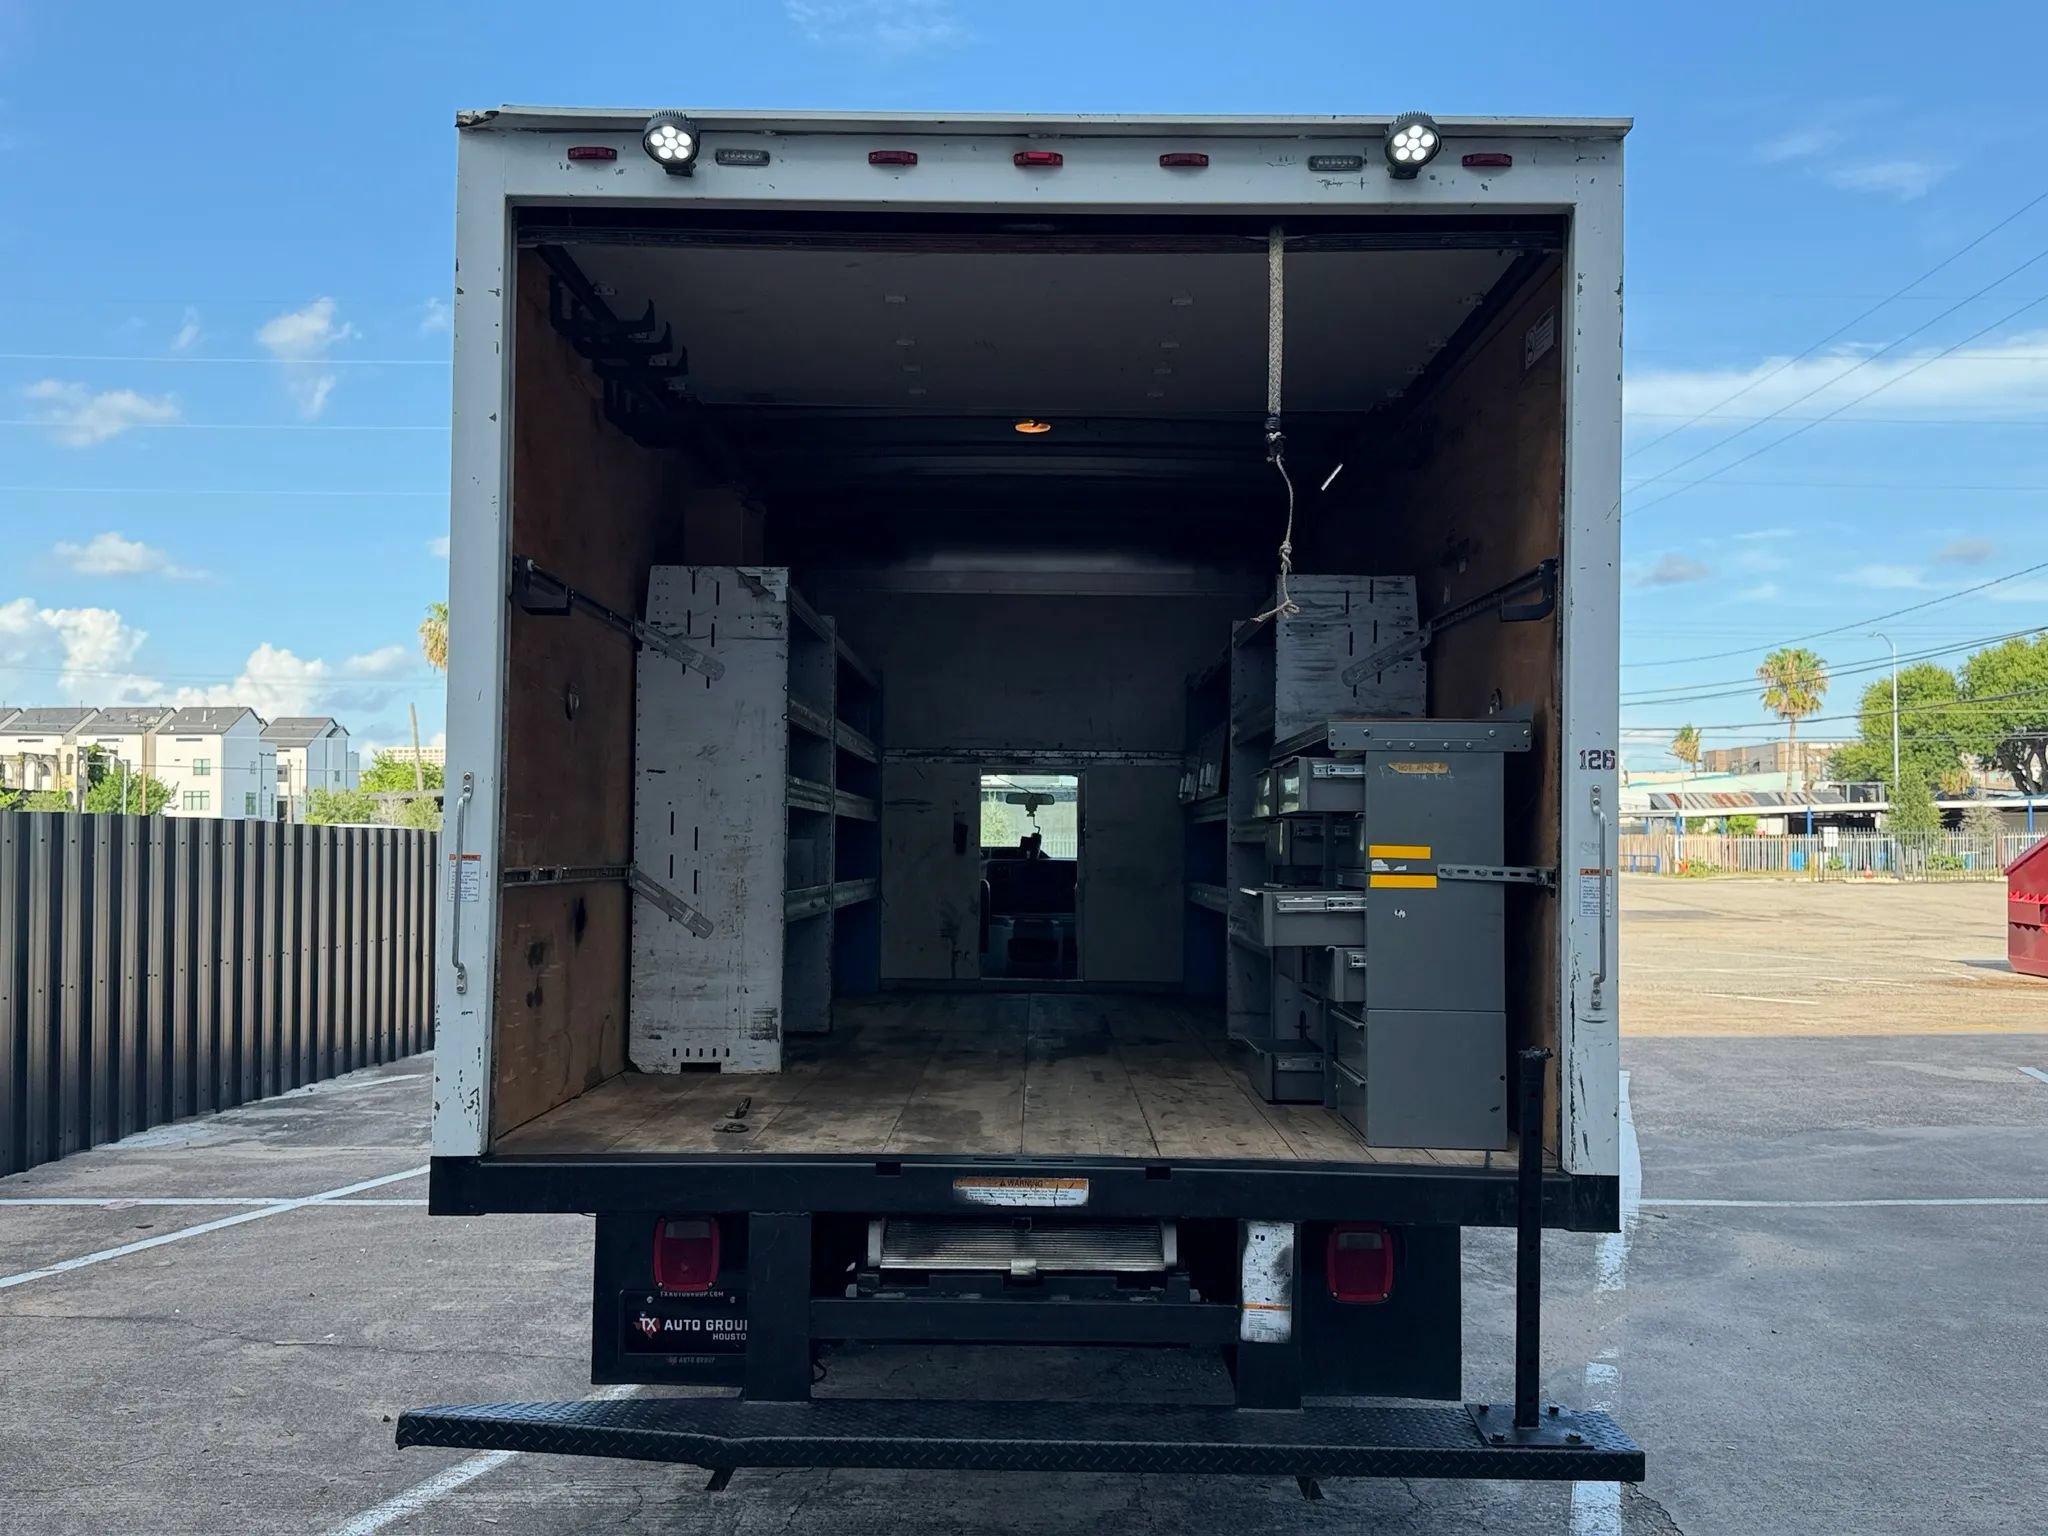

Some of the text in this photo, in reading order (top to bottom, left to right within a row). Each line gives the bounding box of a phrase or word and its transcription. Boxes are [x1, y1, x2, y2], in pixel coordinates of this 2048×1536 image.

[1579, 749, 1616, 770] 126
[1007, 1179, 1043, 1187] WARNING
[639, 1317, 657, 1332] TX
[664, 1319, 701, 1331] AUTO
[712, 1333, 747, 1341] HOUSTO
